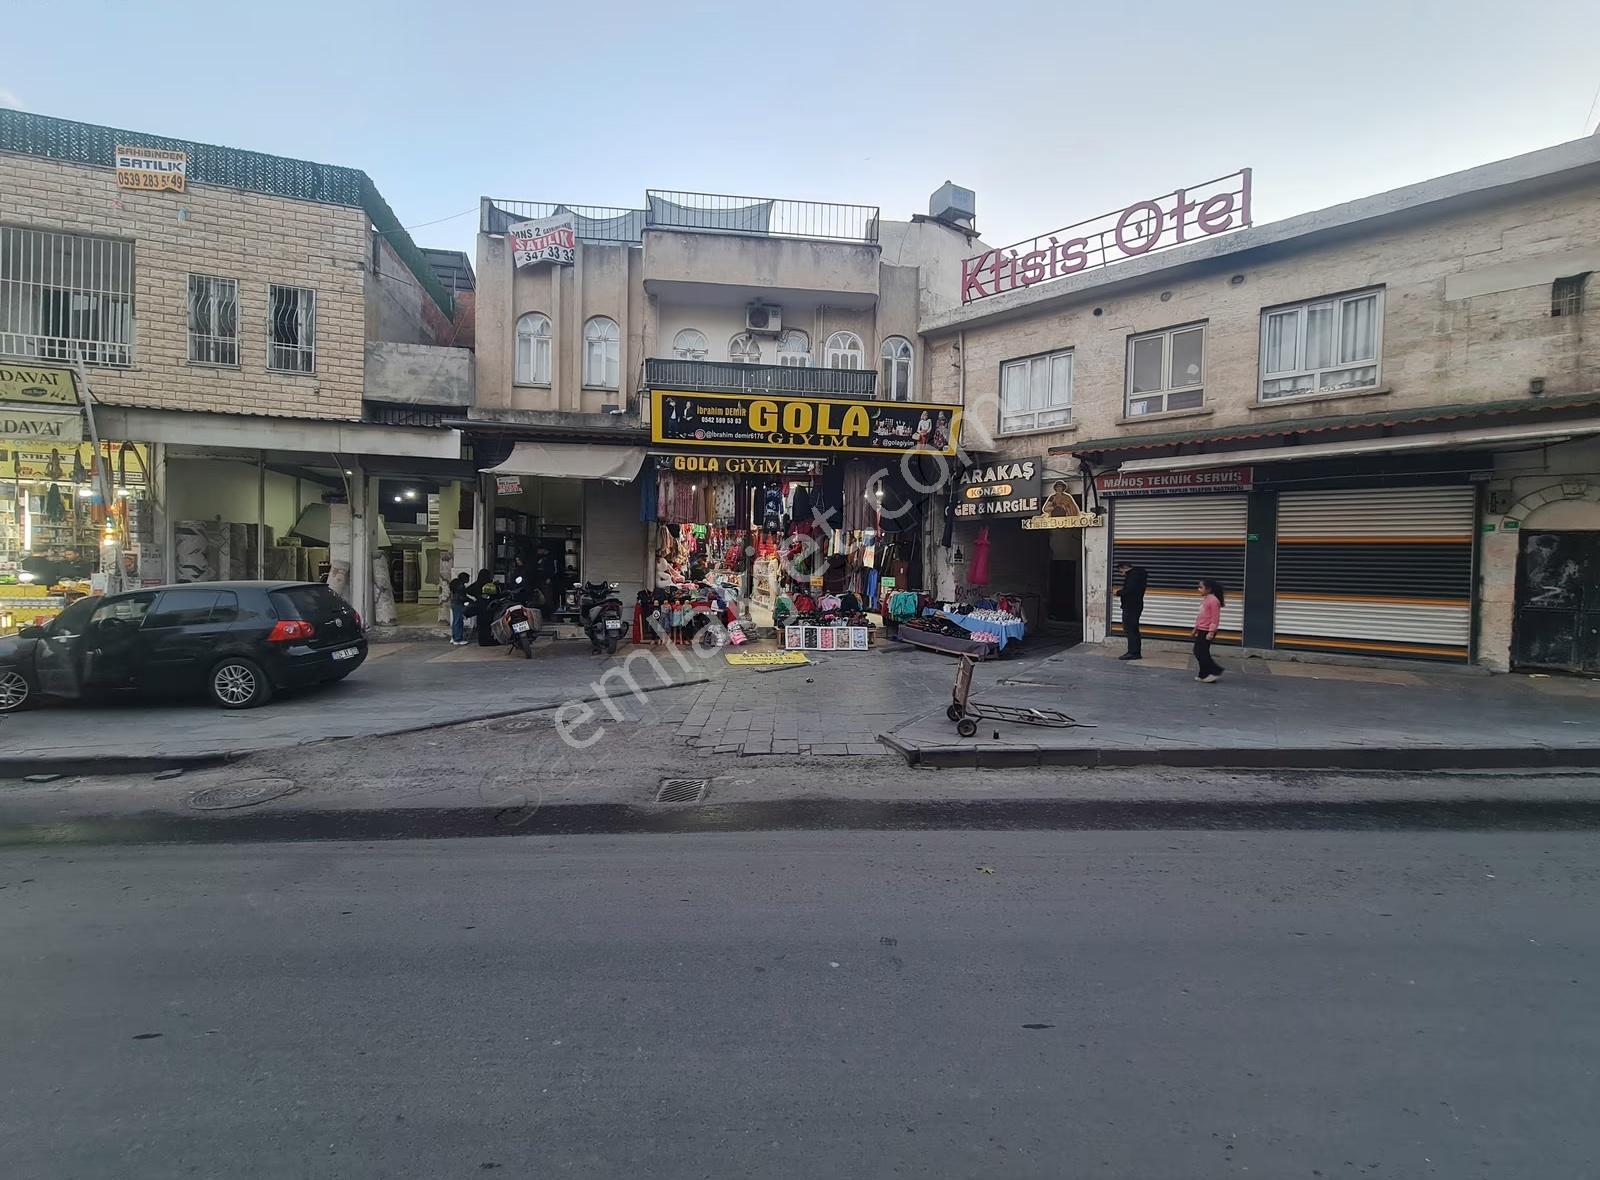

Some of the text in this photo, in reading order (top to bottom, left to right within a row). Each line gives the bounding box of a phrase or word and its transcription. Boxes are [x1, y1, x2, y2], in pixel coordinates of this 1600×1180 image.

[120, 157, 182, 172] SATILIK
[118, 172, 140, 186] 0539
[142, 174, 159, 187] 283
[535, 227, 541, 237] 2
[961, 168, 1252, 305] Ktisis Otel
[515, 231, 570, 251] SATILIK
[525, 250, 544, 262] 347
[548, 246, 560, 259] 33
[748, 400, 870, 437] GOLA
[674, 456, 719, 471] GOLA
[979, 503, 986, 514] &
